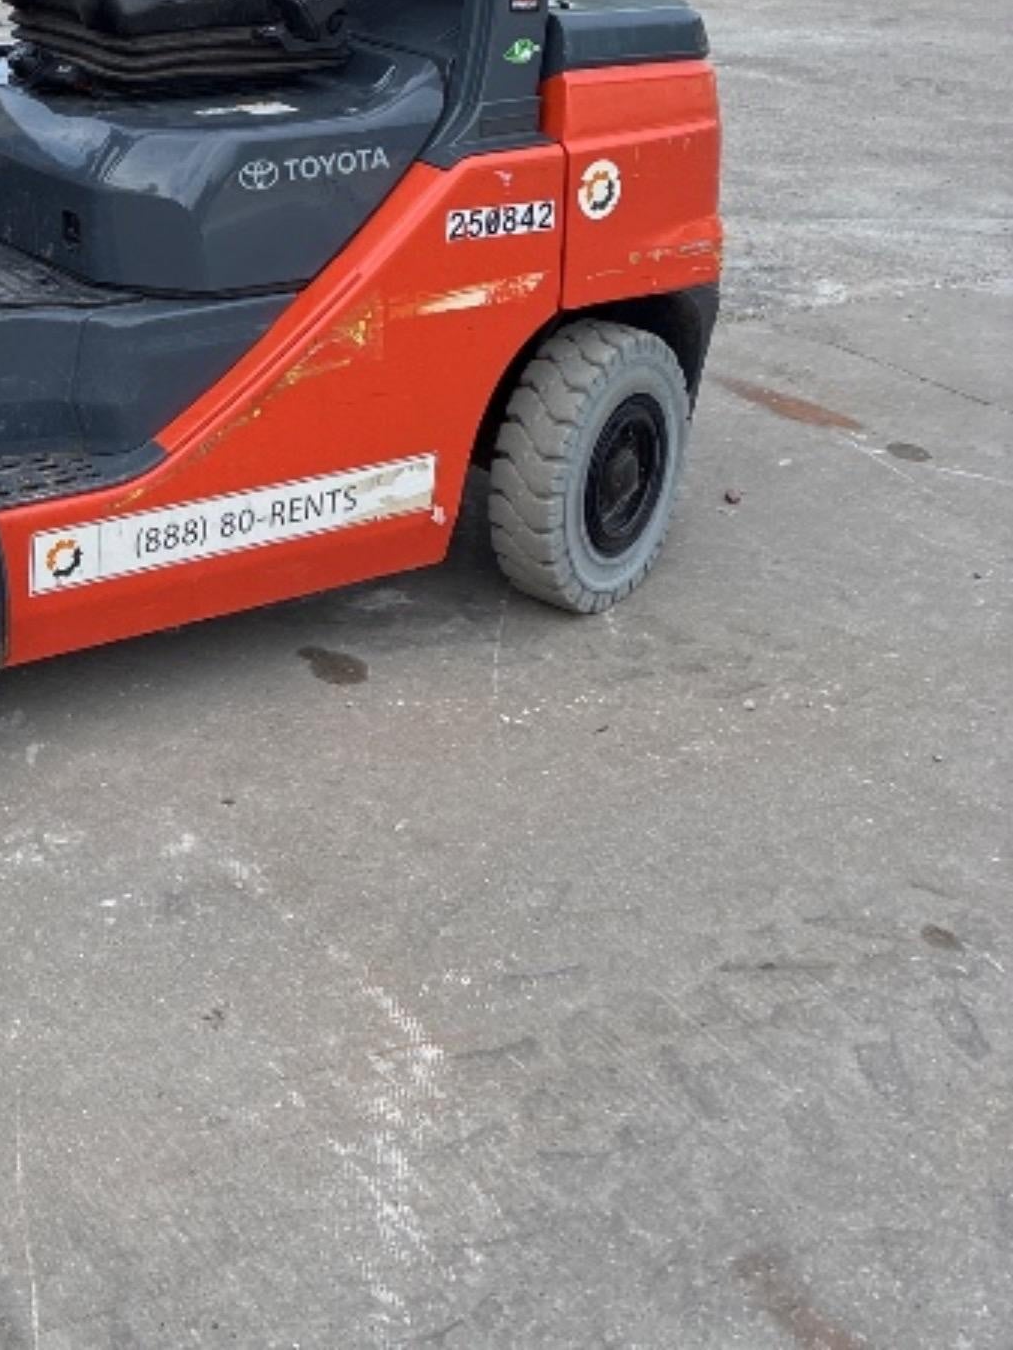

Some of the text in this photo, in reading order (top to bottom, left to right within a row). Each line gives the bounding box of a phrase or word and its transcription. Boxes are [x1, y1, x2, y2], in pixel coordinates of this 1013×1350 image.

[284, 147, 390, 181] TOYOTA
[449, 202, 552, 240] 250842
[135, 485, 358, 558] (888) 80-RENTS
